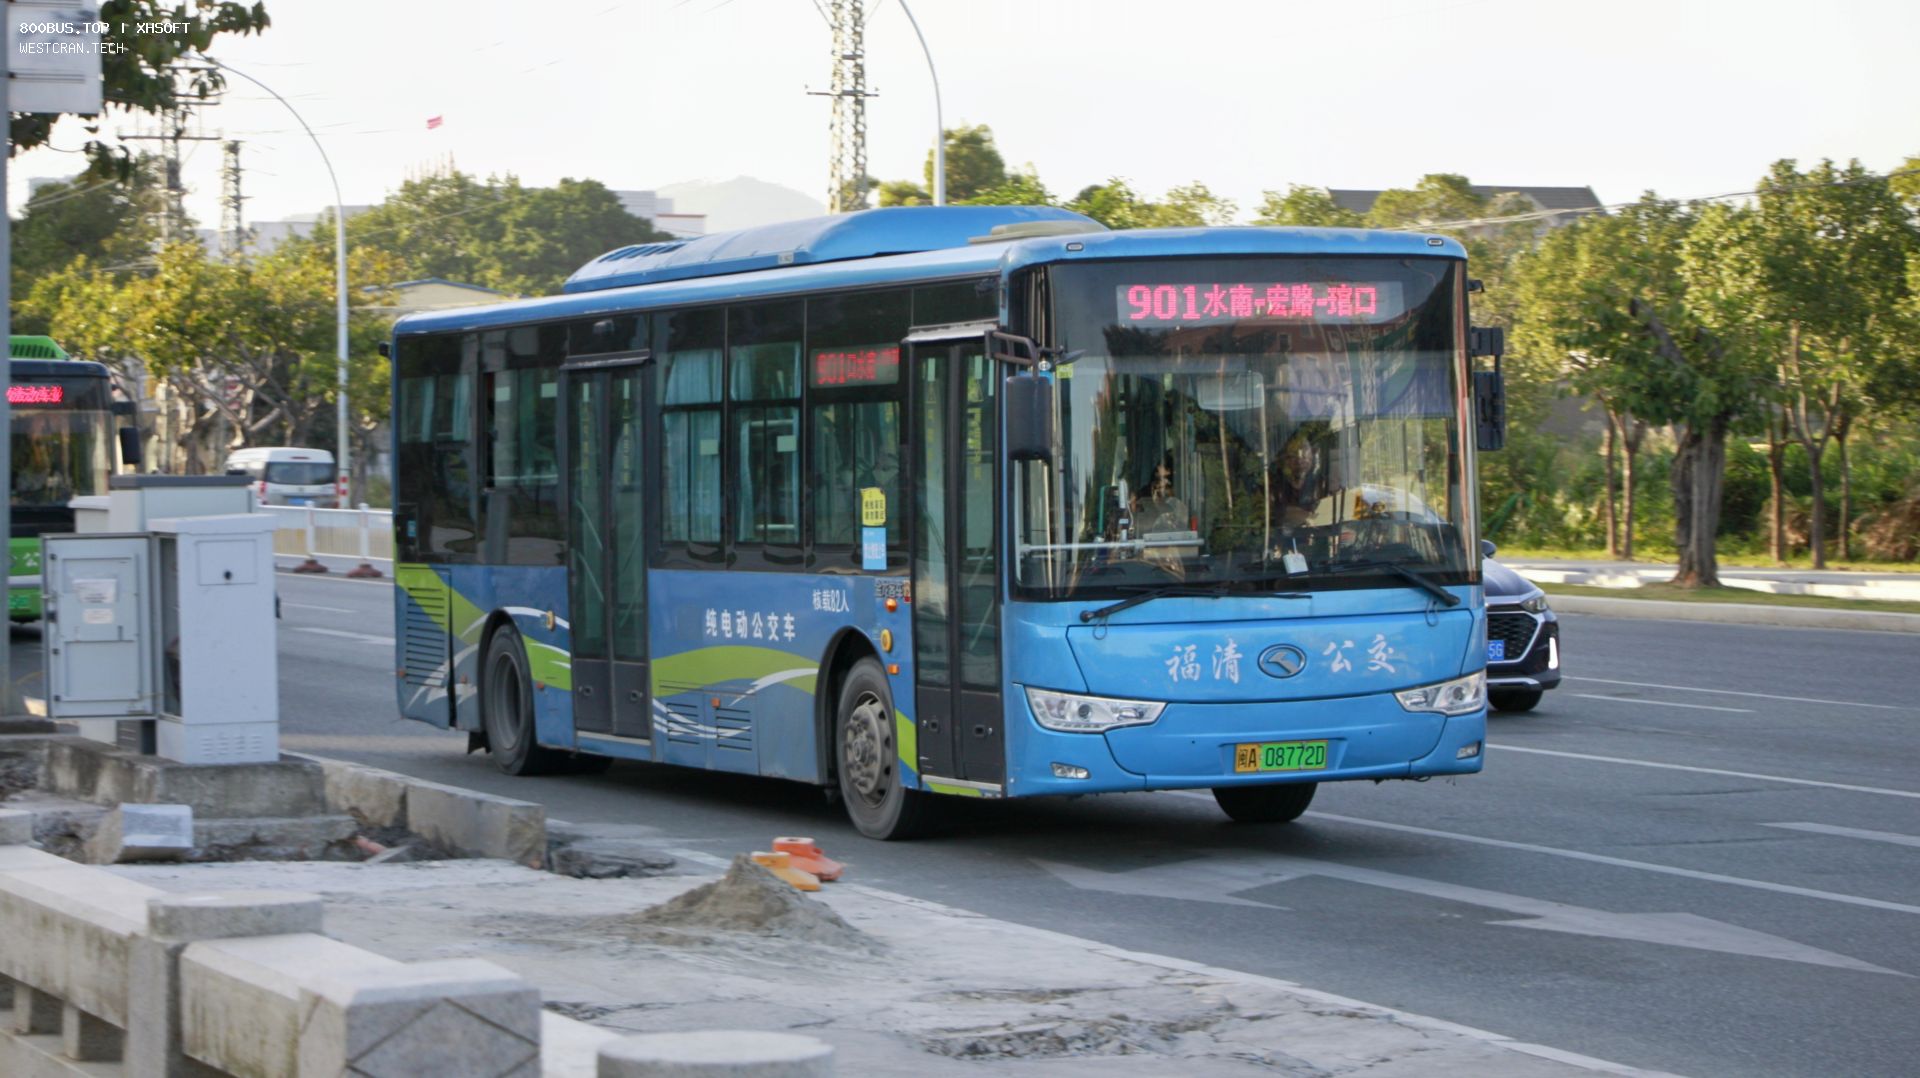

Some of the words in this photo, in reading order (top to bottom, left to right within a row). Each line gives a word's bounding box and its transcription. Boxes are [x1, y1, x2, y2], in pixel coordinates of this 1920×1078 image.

[1127, 284, 1200, 320] 901
[812, 589, 850, 613] 核载82人
[705, 607, 796, 643] 纯电动公交车
[1165, 638, 1243, 684] 福清
[1322, 633, 1396, 674] 公交
[1237, 747, 1257, 769] 闽A
[1264, 745, 1326, 767] 08772D
